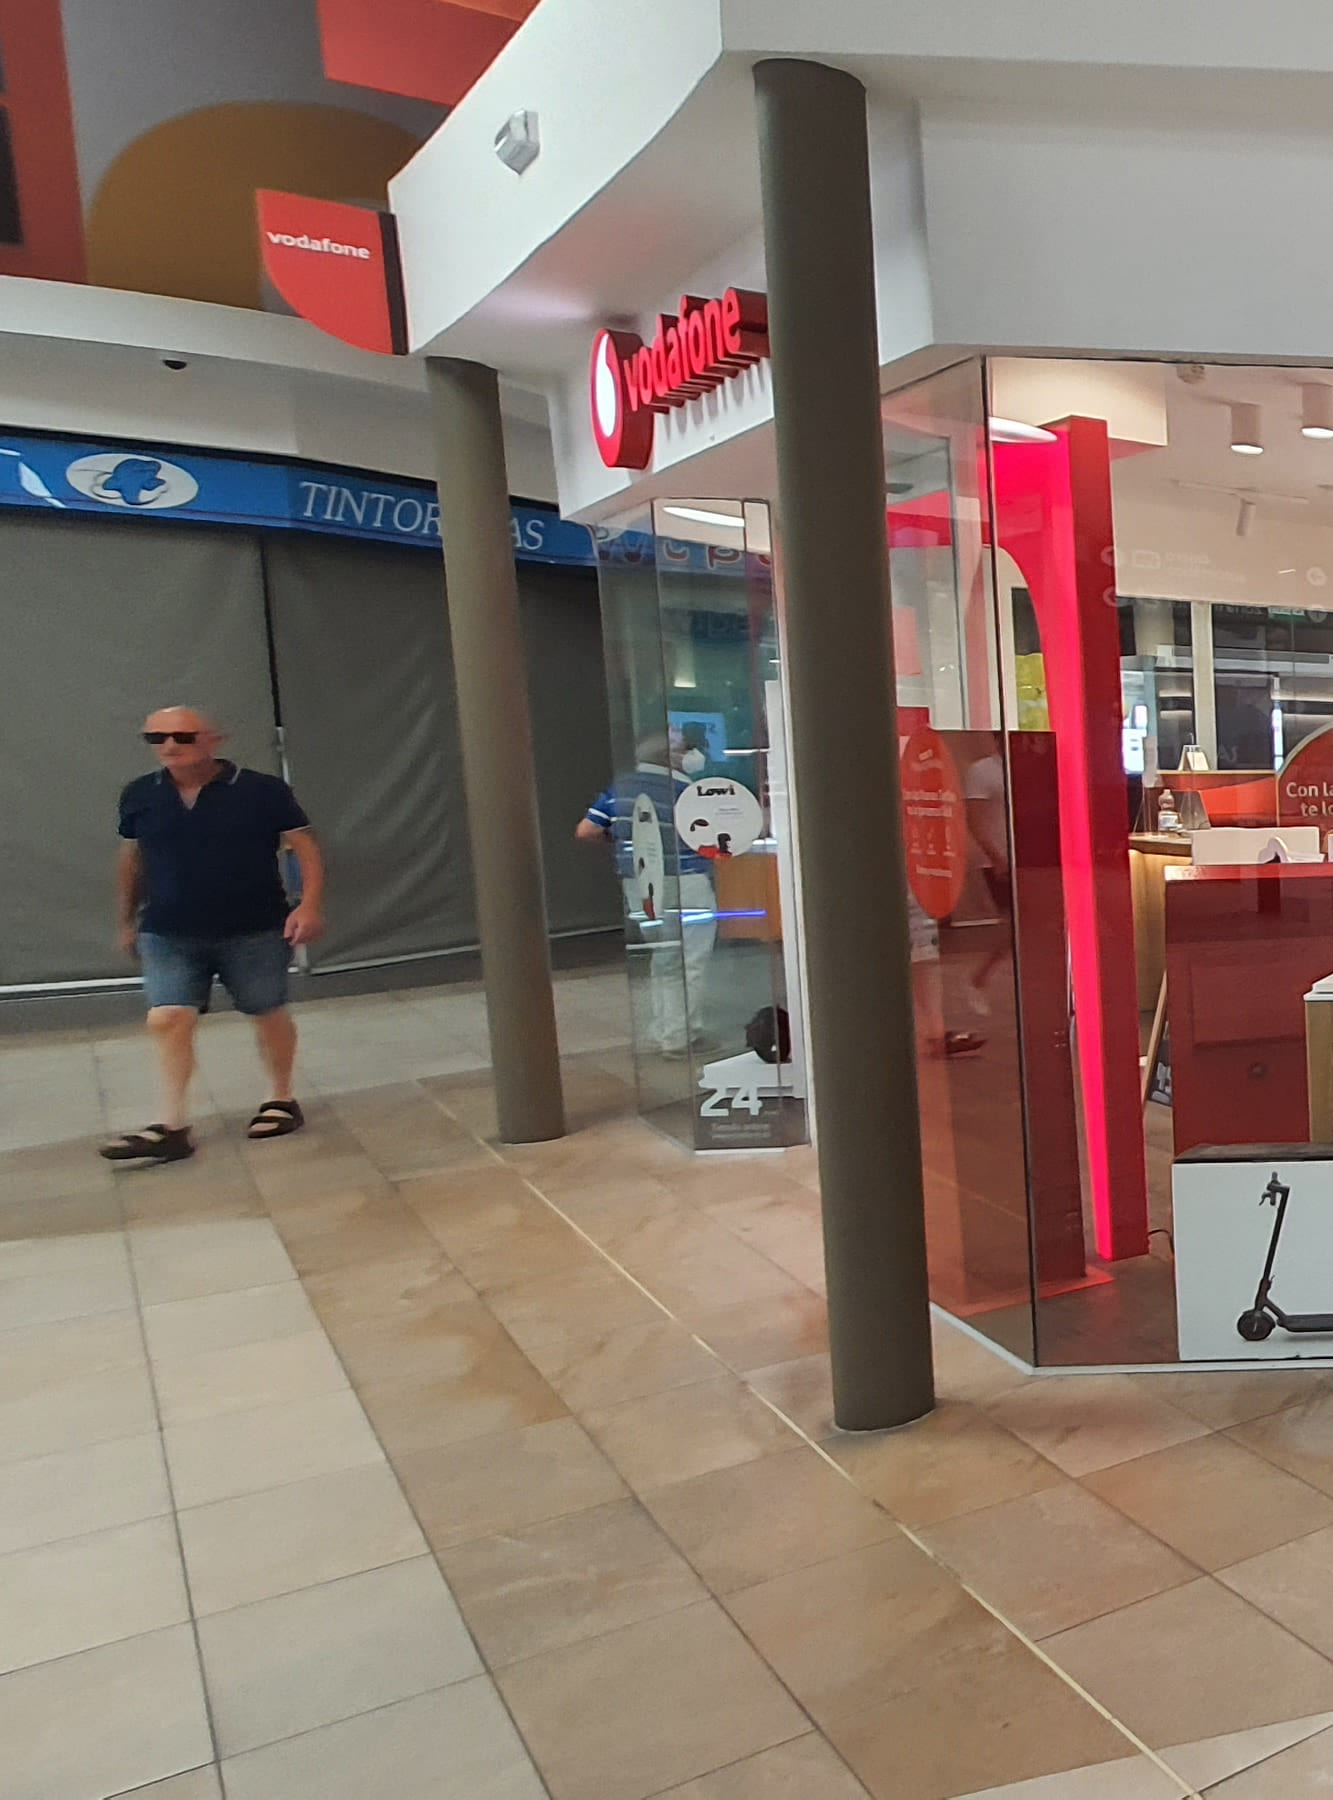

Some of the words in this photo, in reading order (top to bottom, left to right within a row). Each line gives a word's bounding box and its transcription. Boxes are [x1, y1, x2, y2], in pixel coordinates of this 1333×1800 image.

[266, 230, 370, 260] vodafone
[622, 287, 742, 411] vodafone
[302, 481, 545, 551] TINTORAS
[697, 784, 736, 796] Lowi
[1286, 782, 1319, 798] Con
[1300, 802, 1319, 817] te
[700, 1083, 763, 1117] 24
